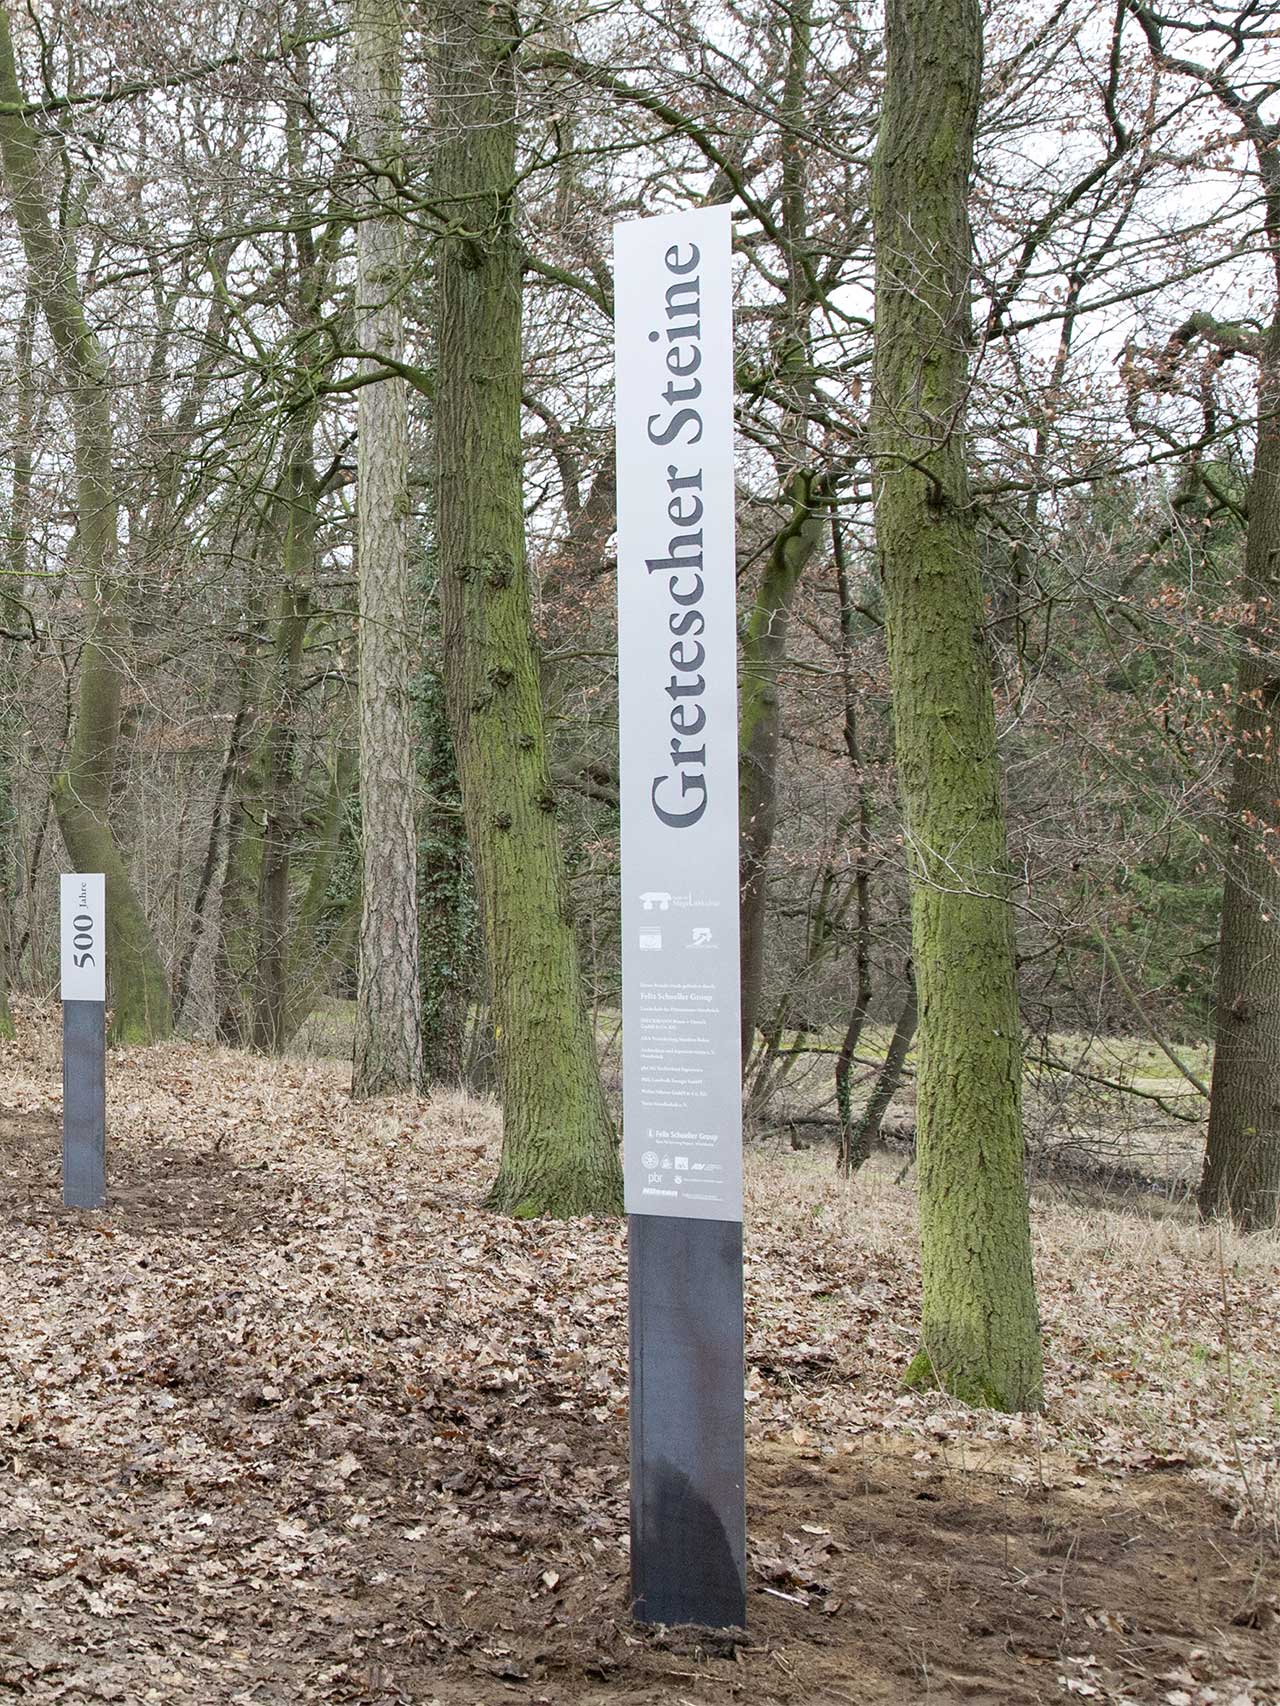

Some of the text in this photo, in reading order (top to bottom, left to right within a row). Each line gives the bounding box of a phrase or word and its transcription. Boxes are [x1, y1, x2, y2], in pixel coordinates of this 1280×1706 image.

[648, 242, 703, 446] Steine
[645, 464, 708, 829] Gretescher
[73, 882, 96, 969] 500 Jahre
[648, 1171, 663, 1185] pbr
